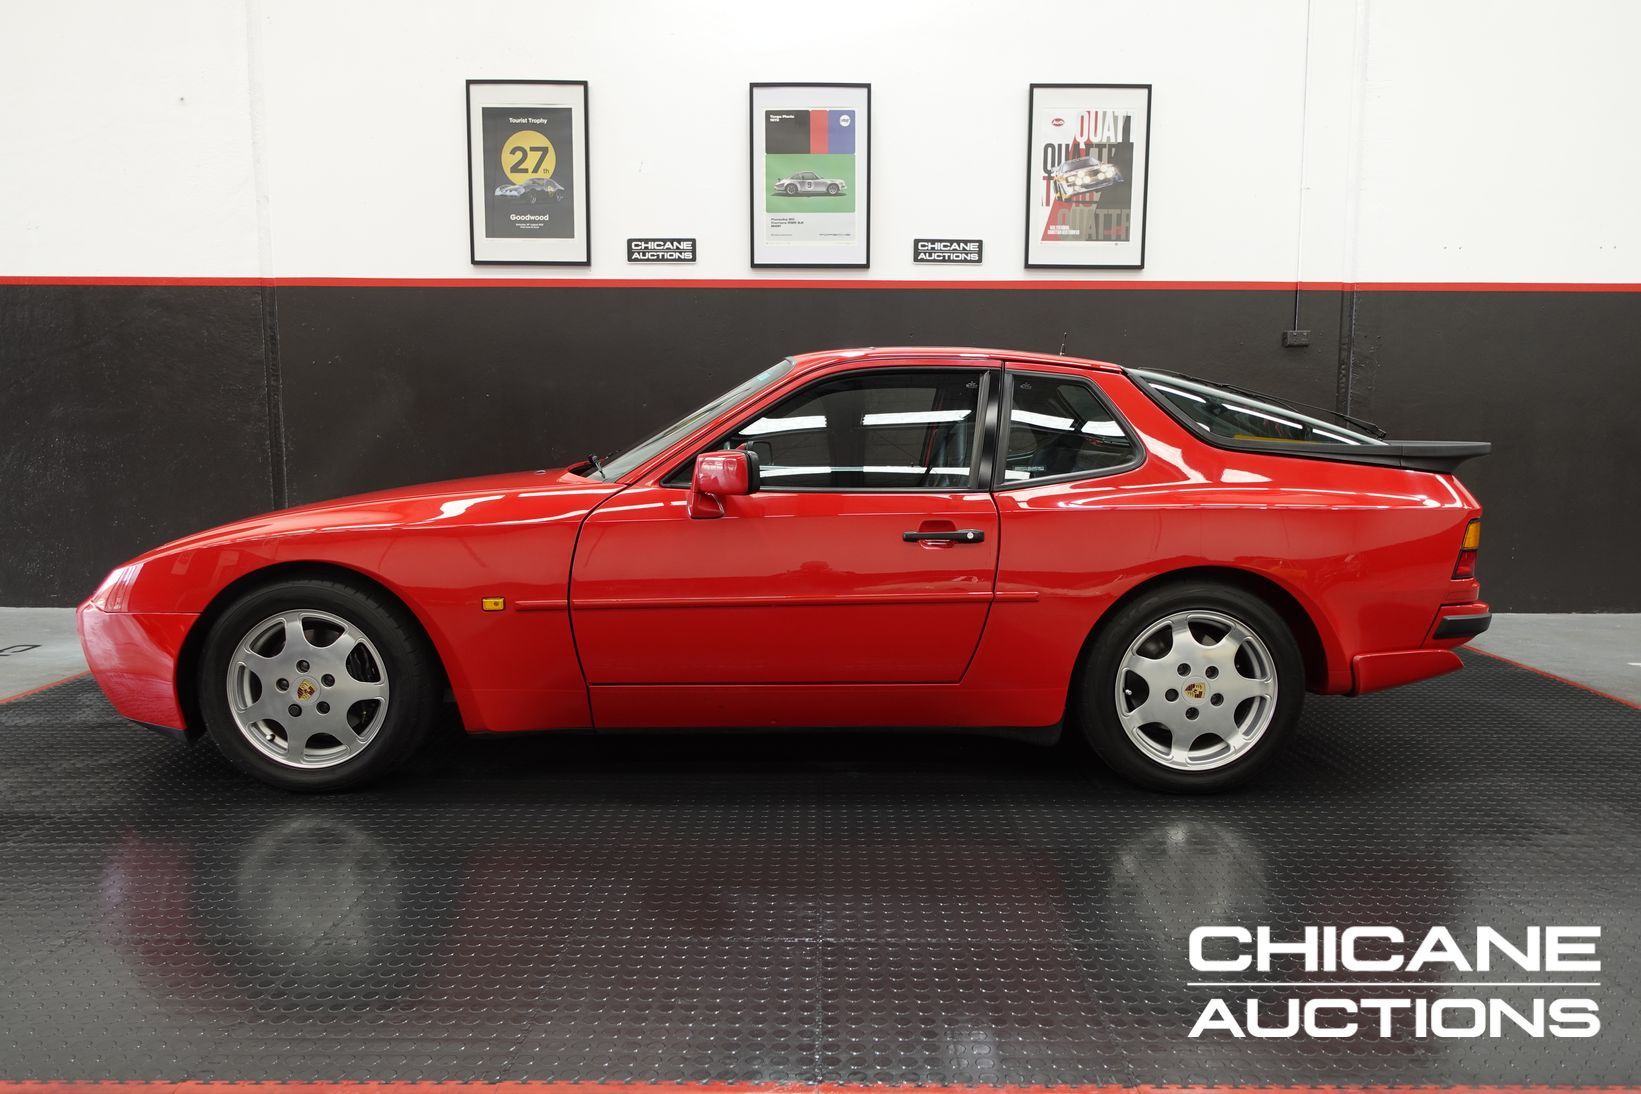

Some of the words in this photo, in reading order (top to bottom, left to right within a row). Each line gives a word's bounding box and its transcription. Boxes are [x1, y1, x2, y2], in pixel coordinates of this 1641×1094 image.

[528, 117, 548, 125] Trophy
[510, 213, 549, 221] Goodwood
[631, 241, 693, 250] CHICANE
[917, 242, 980, 251] CHICANE
[631, 251, 693, 260] AUCTIONS
[917, 252, 979, 261] AUCTIONS
